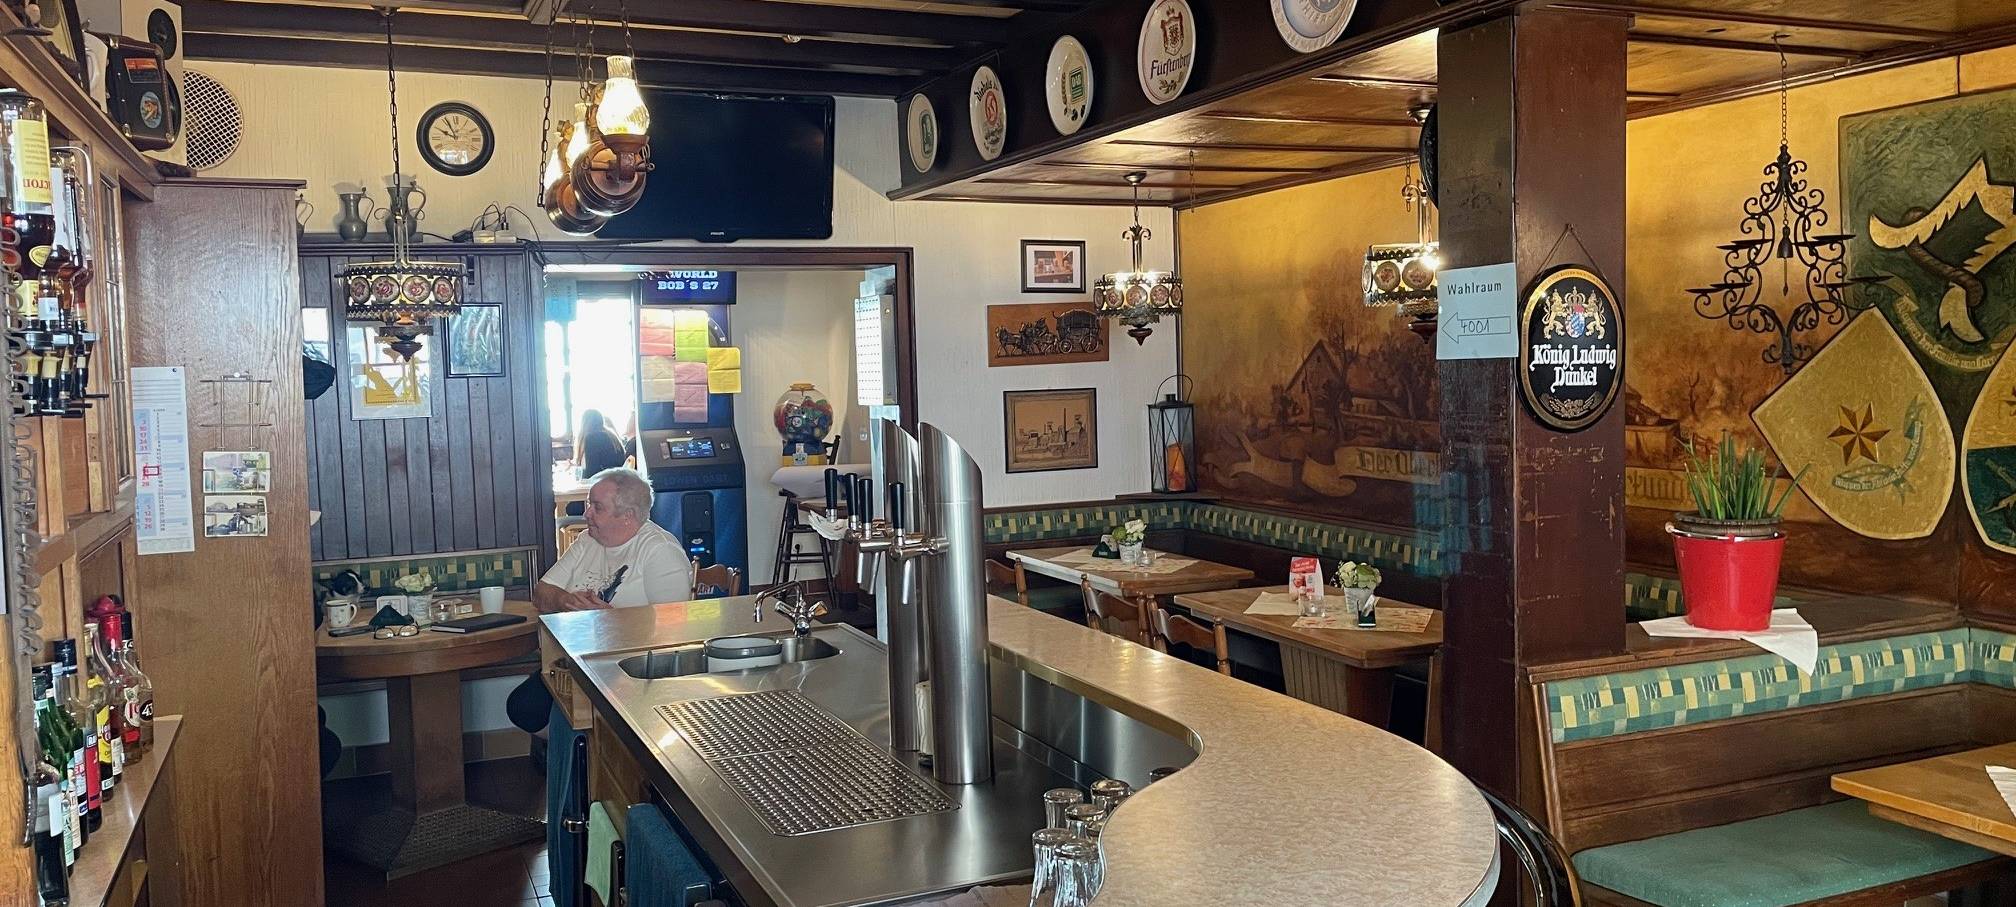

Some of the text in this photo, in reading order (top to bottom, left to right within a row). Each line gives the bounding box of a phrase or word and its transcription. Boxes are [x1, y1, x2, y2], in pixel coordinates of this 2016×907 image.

[702, 281, 719, 290] 27
[1447, 282, 1502, 296] Wahlraum
[1461, 318, 1490, 333] 4001
[1529, 344, 1616, 371] König Ludwig
[1550, 366, 1597, 393] Dunkel
